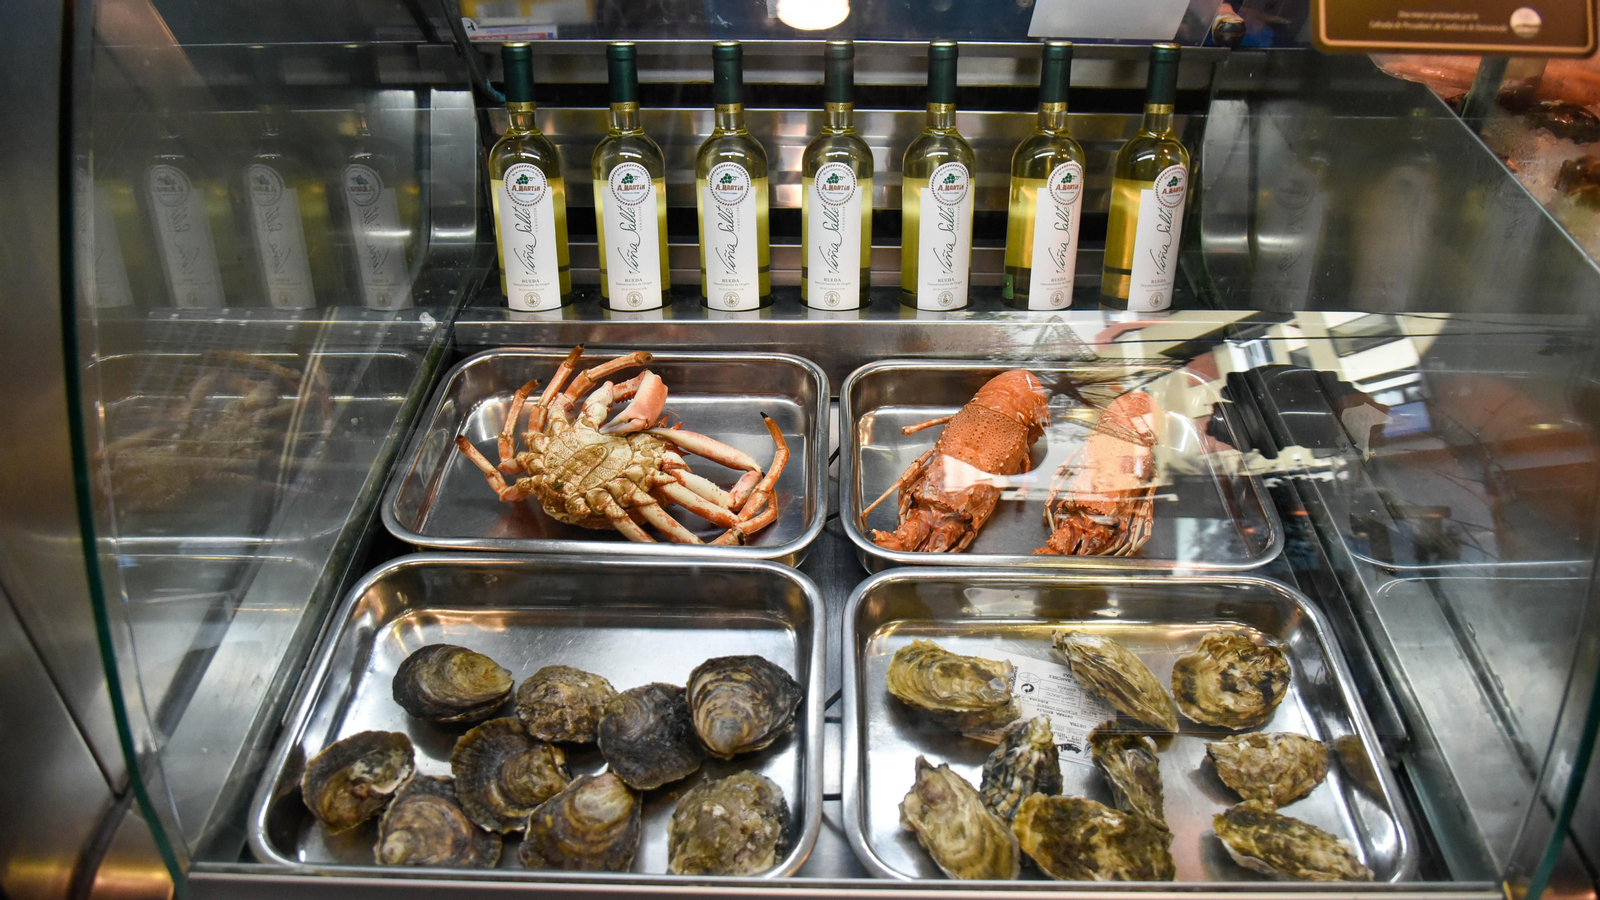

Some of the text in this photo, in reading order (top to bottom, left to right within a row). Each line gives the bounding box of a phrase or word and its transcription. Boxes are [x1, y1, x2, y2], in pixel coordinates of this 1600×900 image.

[513, 243, 538, 276] Viña
[617, 242, 641, 275] Viña
[715, 243, 738, 275] Viña
[818, 243, 840, 275] Viña
[933, 242, 957, 275] Viña
[1047, 240, 1070, 274] Viña
[1149, 243, 1169, 275] Viña
